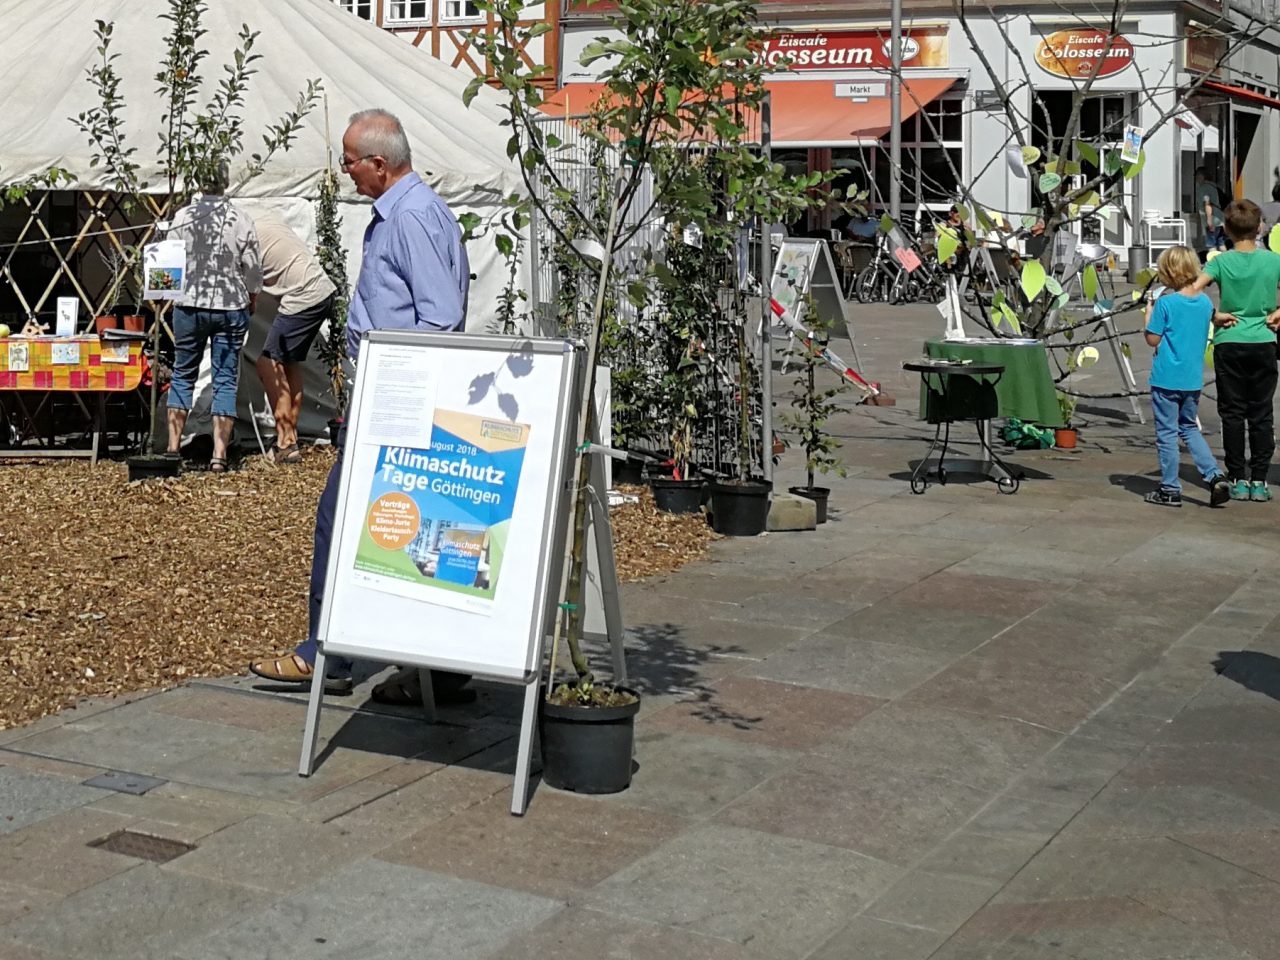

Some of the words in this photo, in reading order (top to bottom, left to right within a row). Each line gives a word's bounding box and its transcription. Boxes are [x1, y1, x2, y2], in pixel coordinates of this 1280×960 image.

[778, 34, 828, 47] Eiscafe
[1068, 35, 1104, 44] Eiscafe
[725, 41, 873, 66] olosseum
[850, 85, 871, 93] Markt
[431, 441, 454, 452] ugust
[456, 444, 477, 456] 2018
[384, 446, 506, 485] Klimaschutz
[381, 463, 429, 491] Tage
[431, 478, 501, 505] Göttingen
